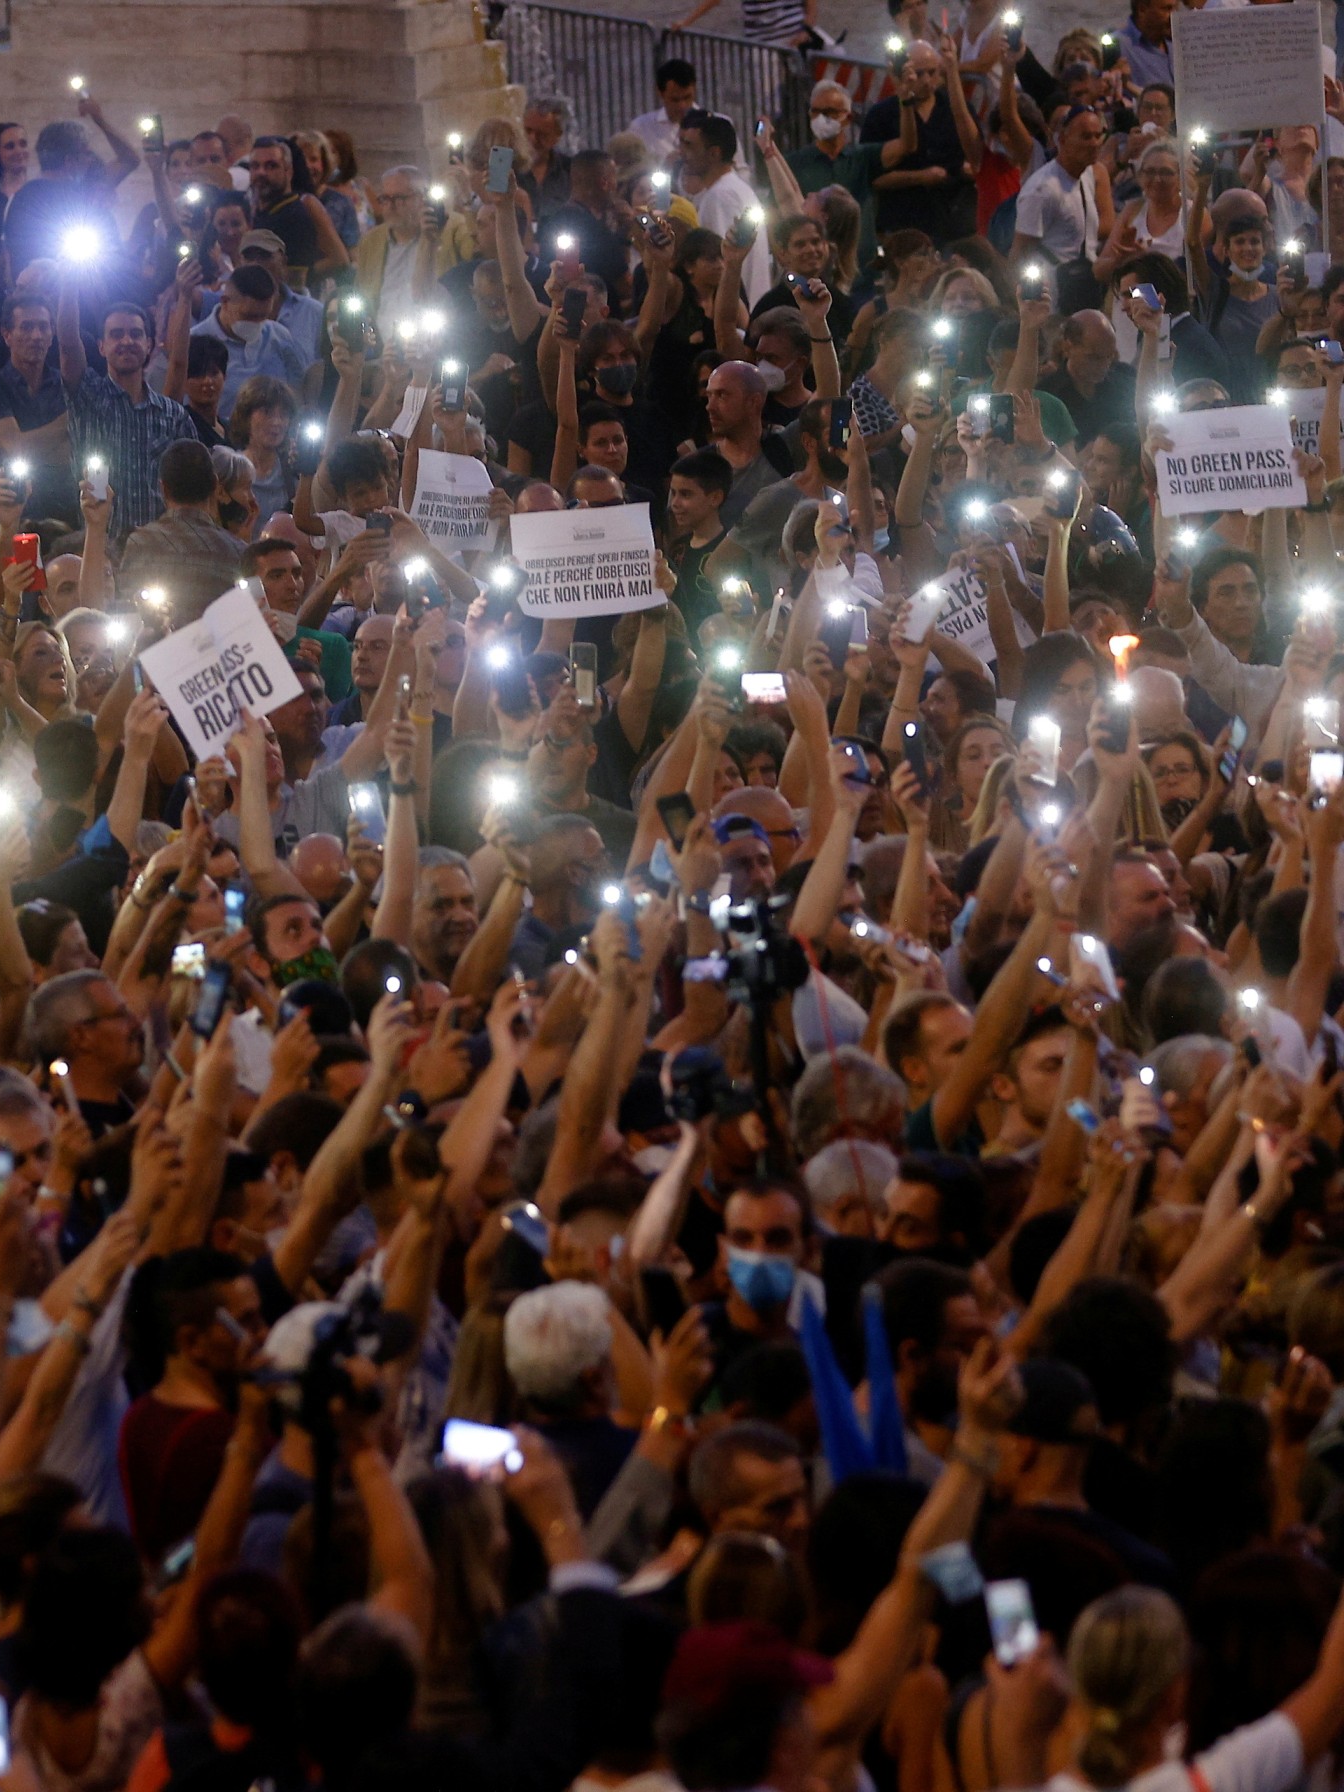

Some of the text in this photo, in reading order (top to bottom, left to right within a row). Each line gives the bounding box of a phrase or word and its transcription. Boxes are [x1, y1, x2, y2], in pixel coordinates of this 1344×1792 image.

[1166, 457, 1187, 476] NO
[1191, 451, 1242, 474] GREEN
[1169, 471, 1293, 494] SÌ CURE DOMICILIARI
[525, 549, 650, 569] OBBEDISCI PERCHÉ SPERI FINISCA
[527, 562, 651, 585] MA È PERCHÉ OBBEDISCI
[526, 578, 652, 605] CHE NON FINIRÀ MAI
[179, 662, 225, 704] GREEN
